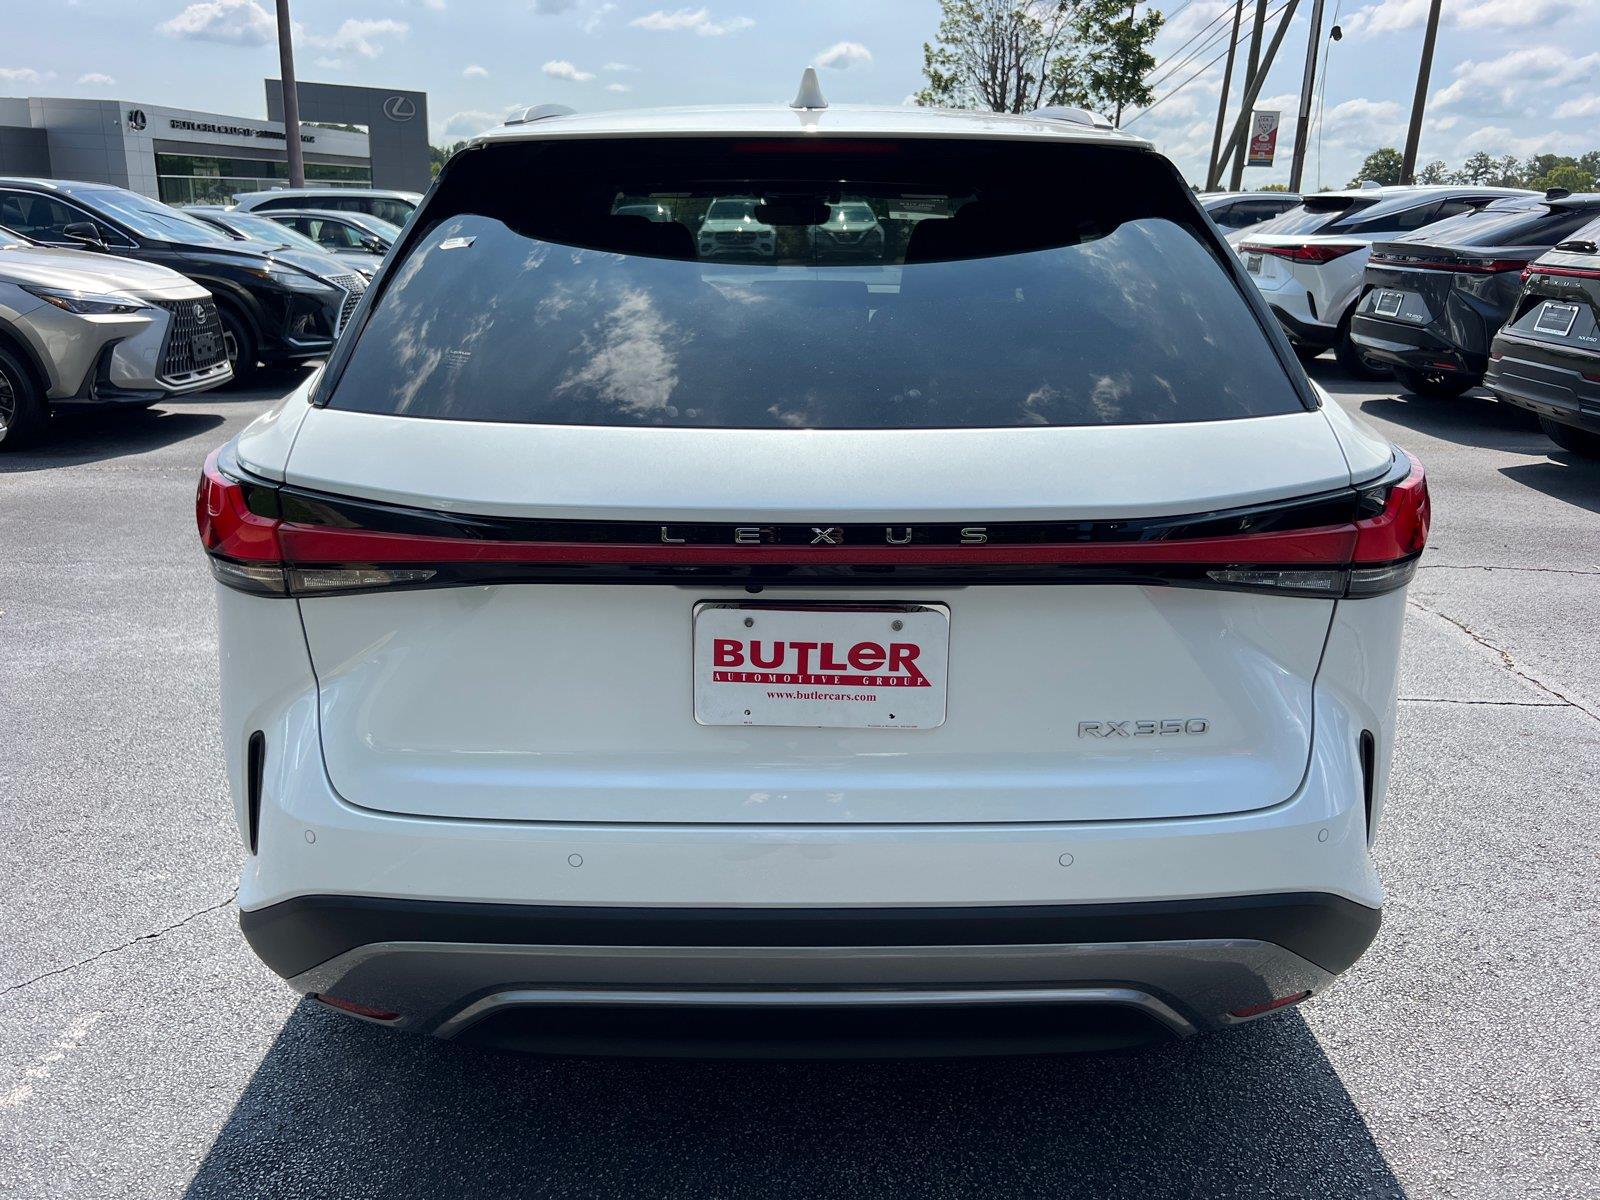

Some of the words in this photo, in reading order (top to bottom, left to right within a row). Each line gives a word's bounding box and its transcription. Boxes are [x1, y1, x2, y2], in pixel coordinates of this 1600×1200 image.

[660, 526, 987, 544] LEXUS
[714, 672, 840, 685] AUTOMOTIVE
[862, 677, 924, 687] GROUP
[766, 690, 877, 702] www.butlercars.com
[1077, 718, 1210, 738] RX350
